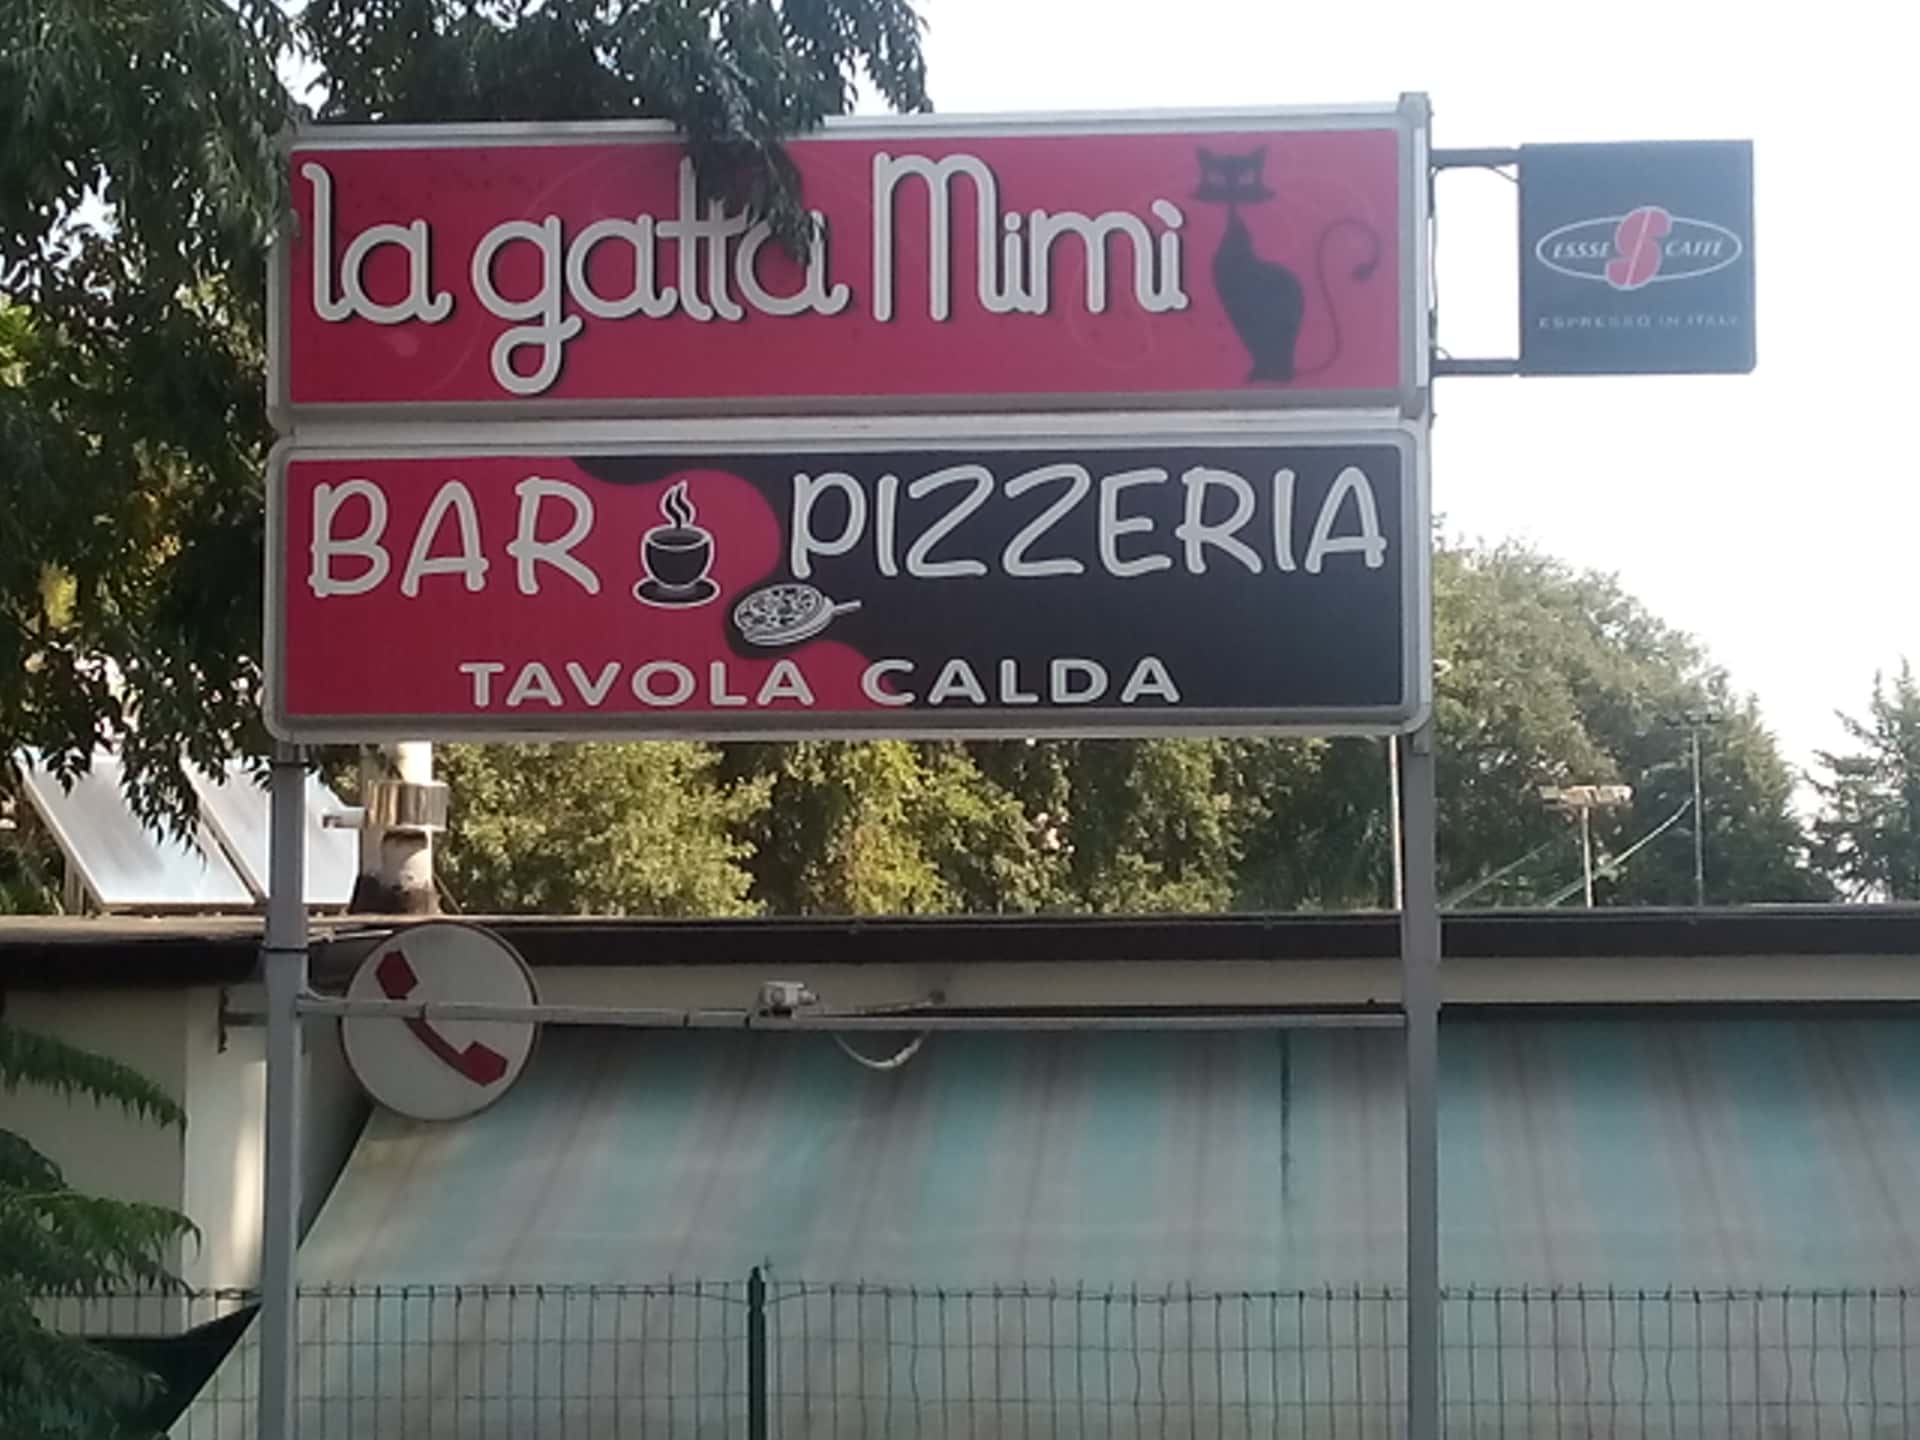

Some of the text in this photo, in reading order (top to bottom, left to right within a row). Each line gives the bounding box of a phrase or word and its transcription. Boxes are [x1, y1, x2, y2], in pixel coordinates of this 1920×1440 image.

[302, 151, 1189, 395] la gatta Mimì
[308, 464, 1388, 598] BAR PIZZERIA
[459, 656, 1181, 708] TAVOLA CALDA
